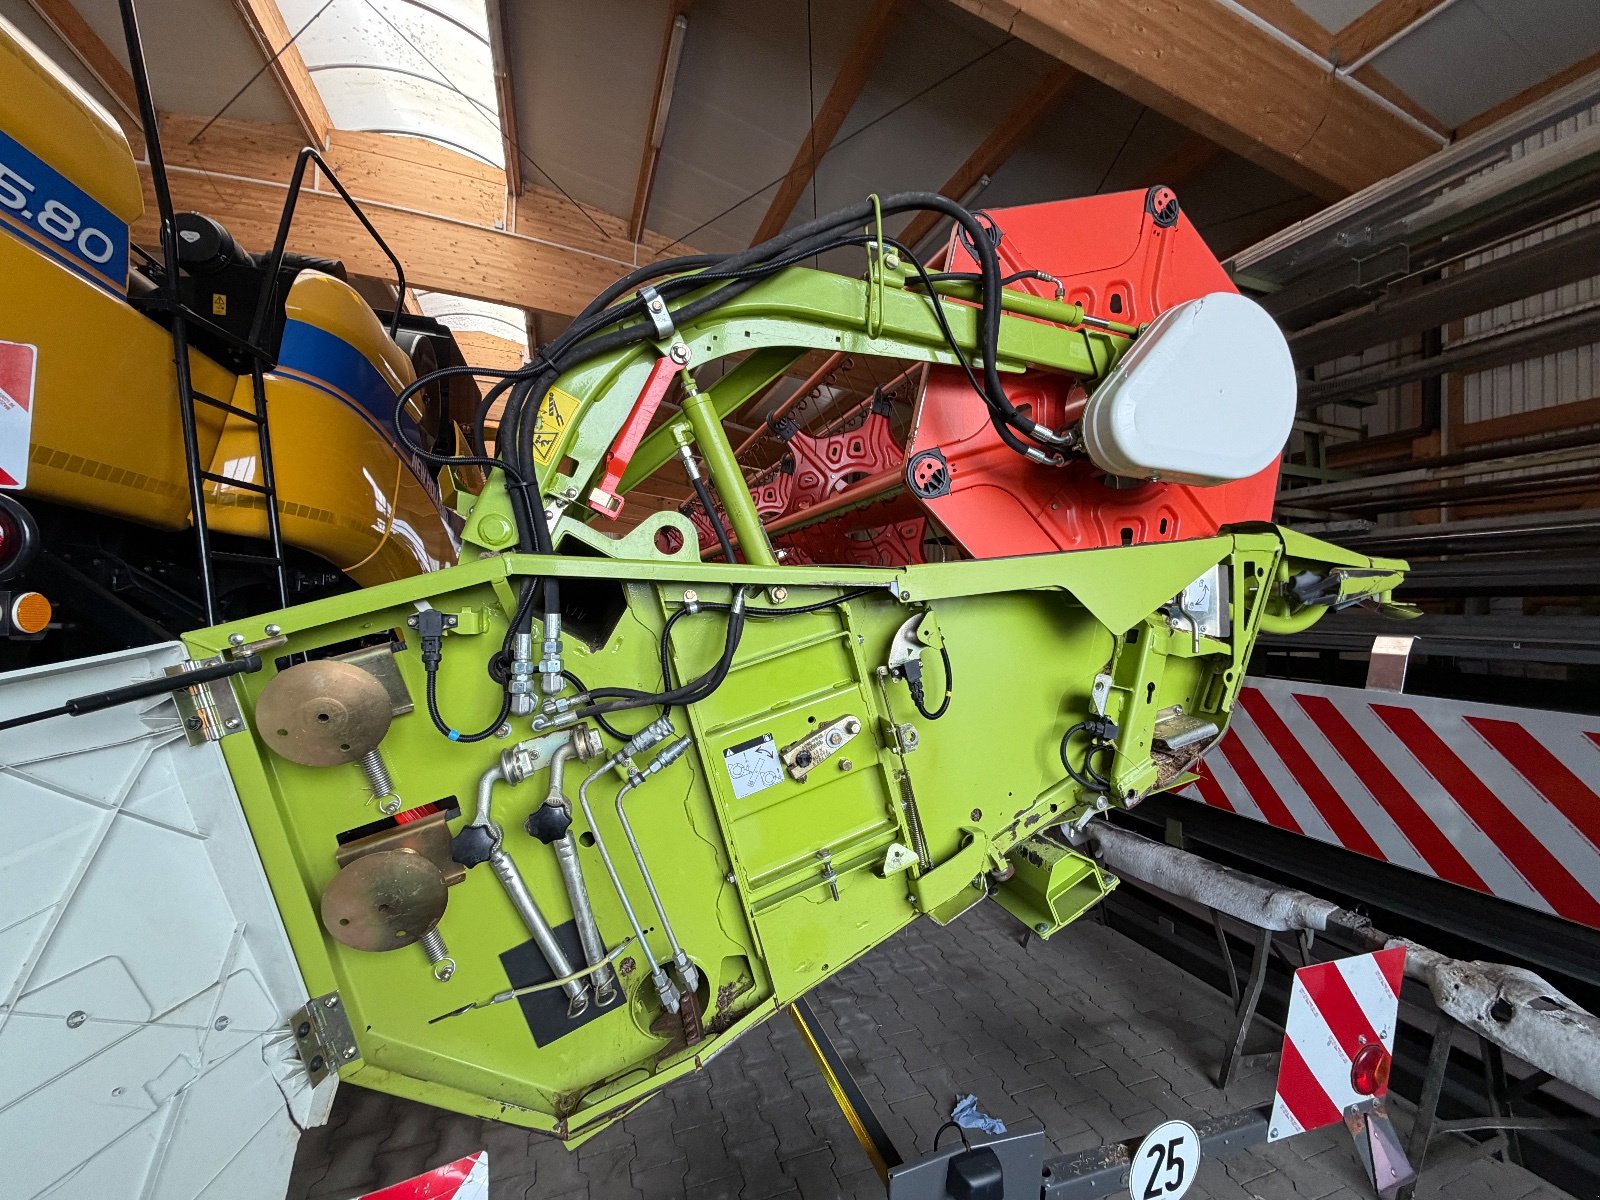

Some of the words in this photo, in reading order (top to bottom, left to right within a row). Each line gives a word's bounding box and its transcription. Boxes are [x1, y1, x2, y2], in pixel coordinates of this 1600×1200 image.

[0, 163, 114, 264] 5.80
[411, 453, 427, 485] NEW
[1143, 1136, 1185, 1200] 25
